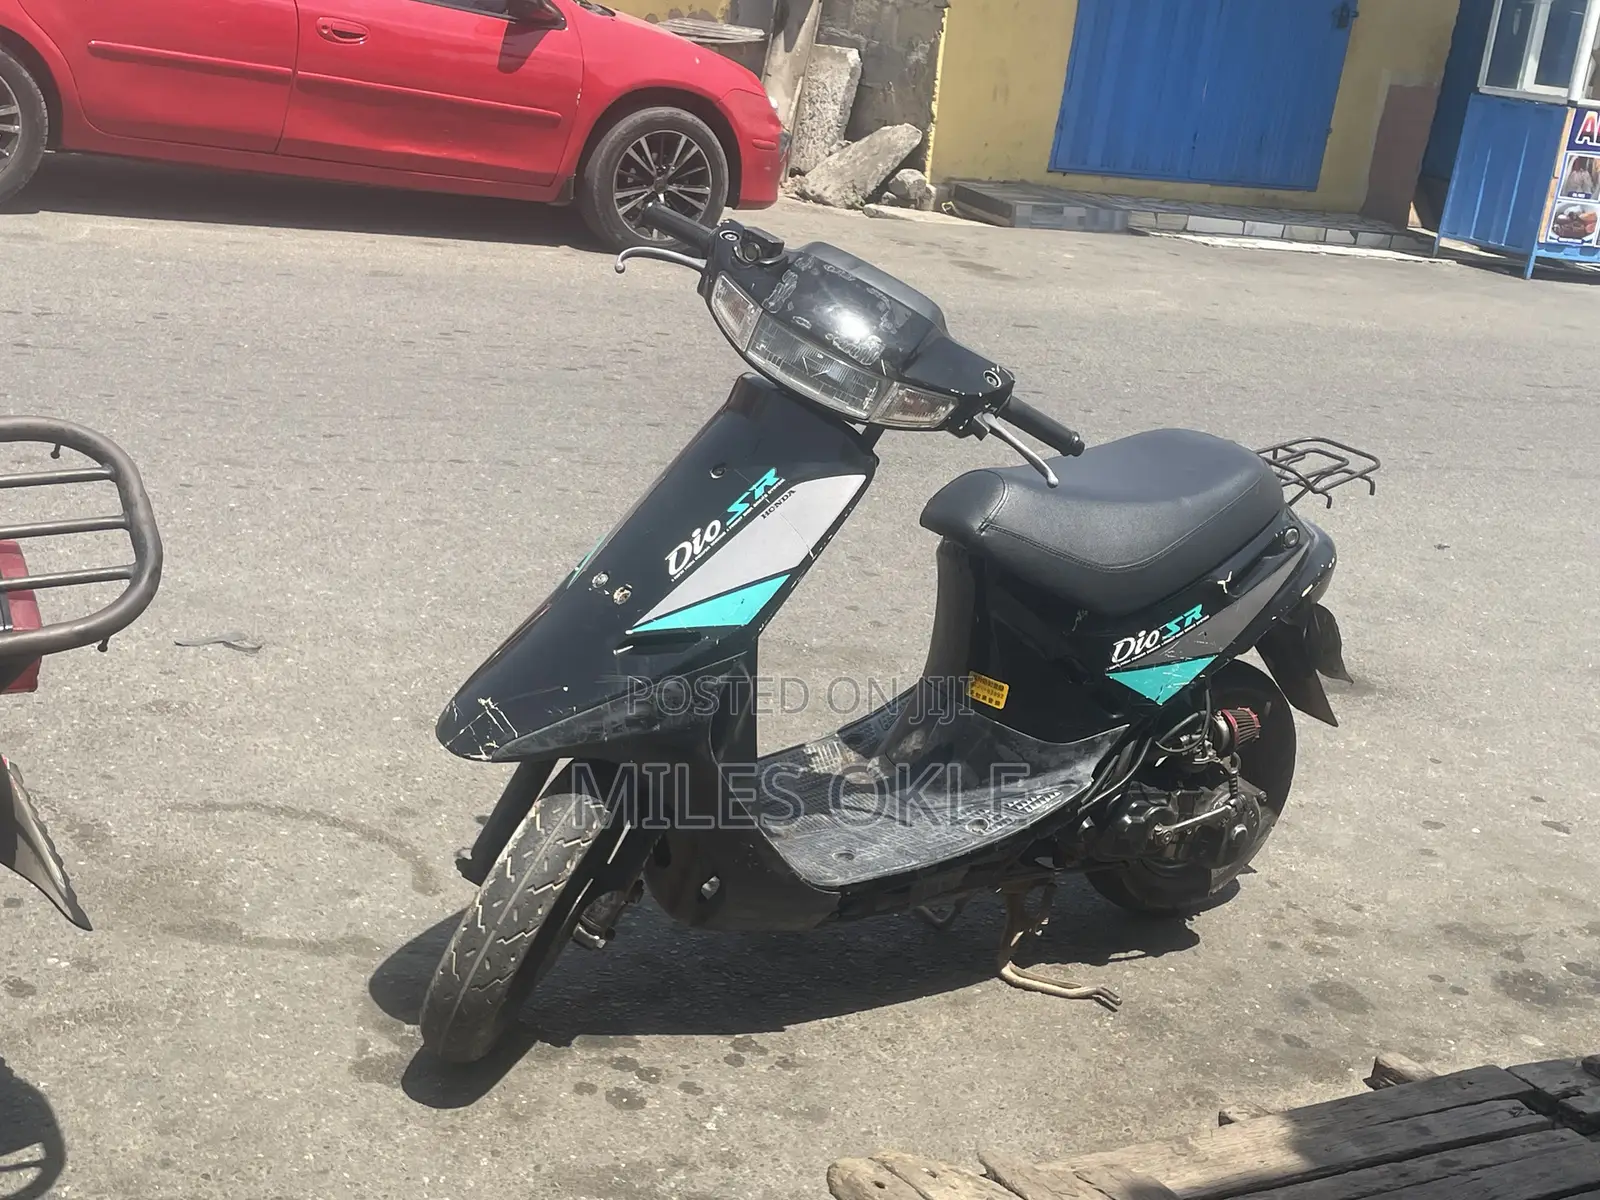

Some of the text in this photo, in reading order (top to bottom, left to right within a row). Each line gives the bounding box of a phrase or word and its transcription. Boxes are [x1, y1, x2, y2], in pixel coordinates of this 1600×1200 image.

[1575, 110, 1600, 146] A
[665, 519, 722, 576] Dio
[726, 467, 781, 526] SR
[761, 489, 796, 520] HONDA
[1111, 630, 1159, 664] Dio
[1160, 604, 1203, 641] SR
